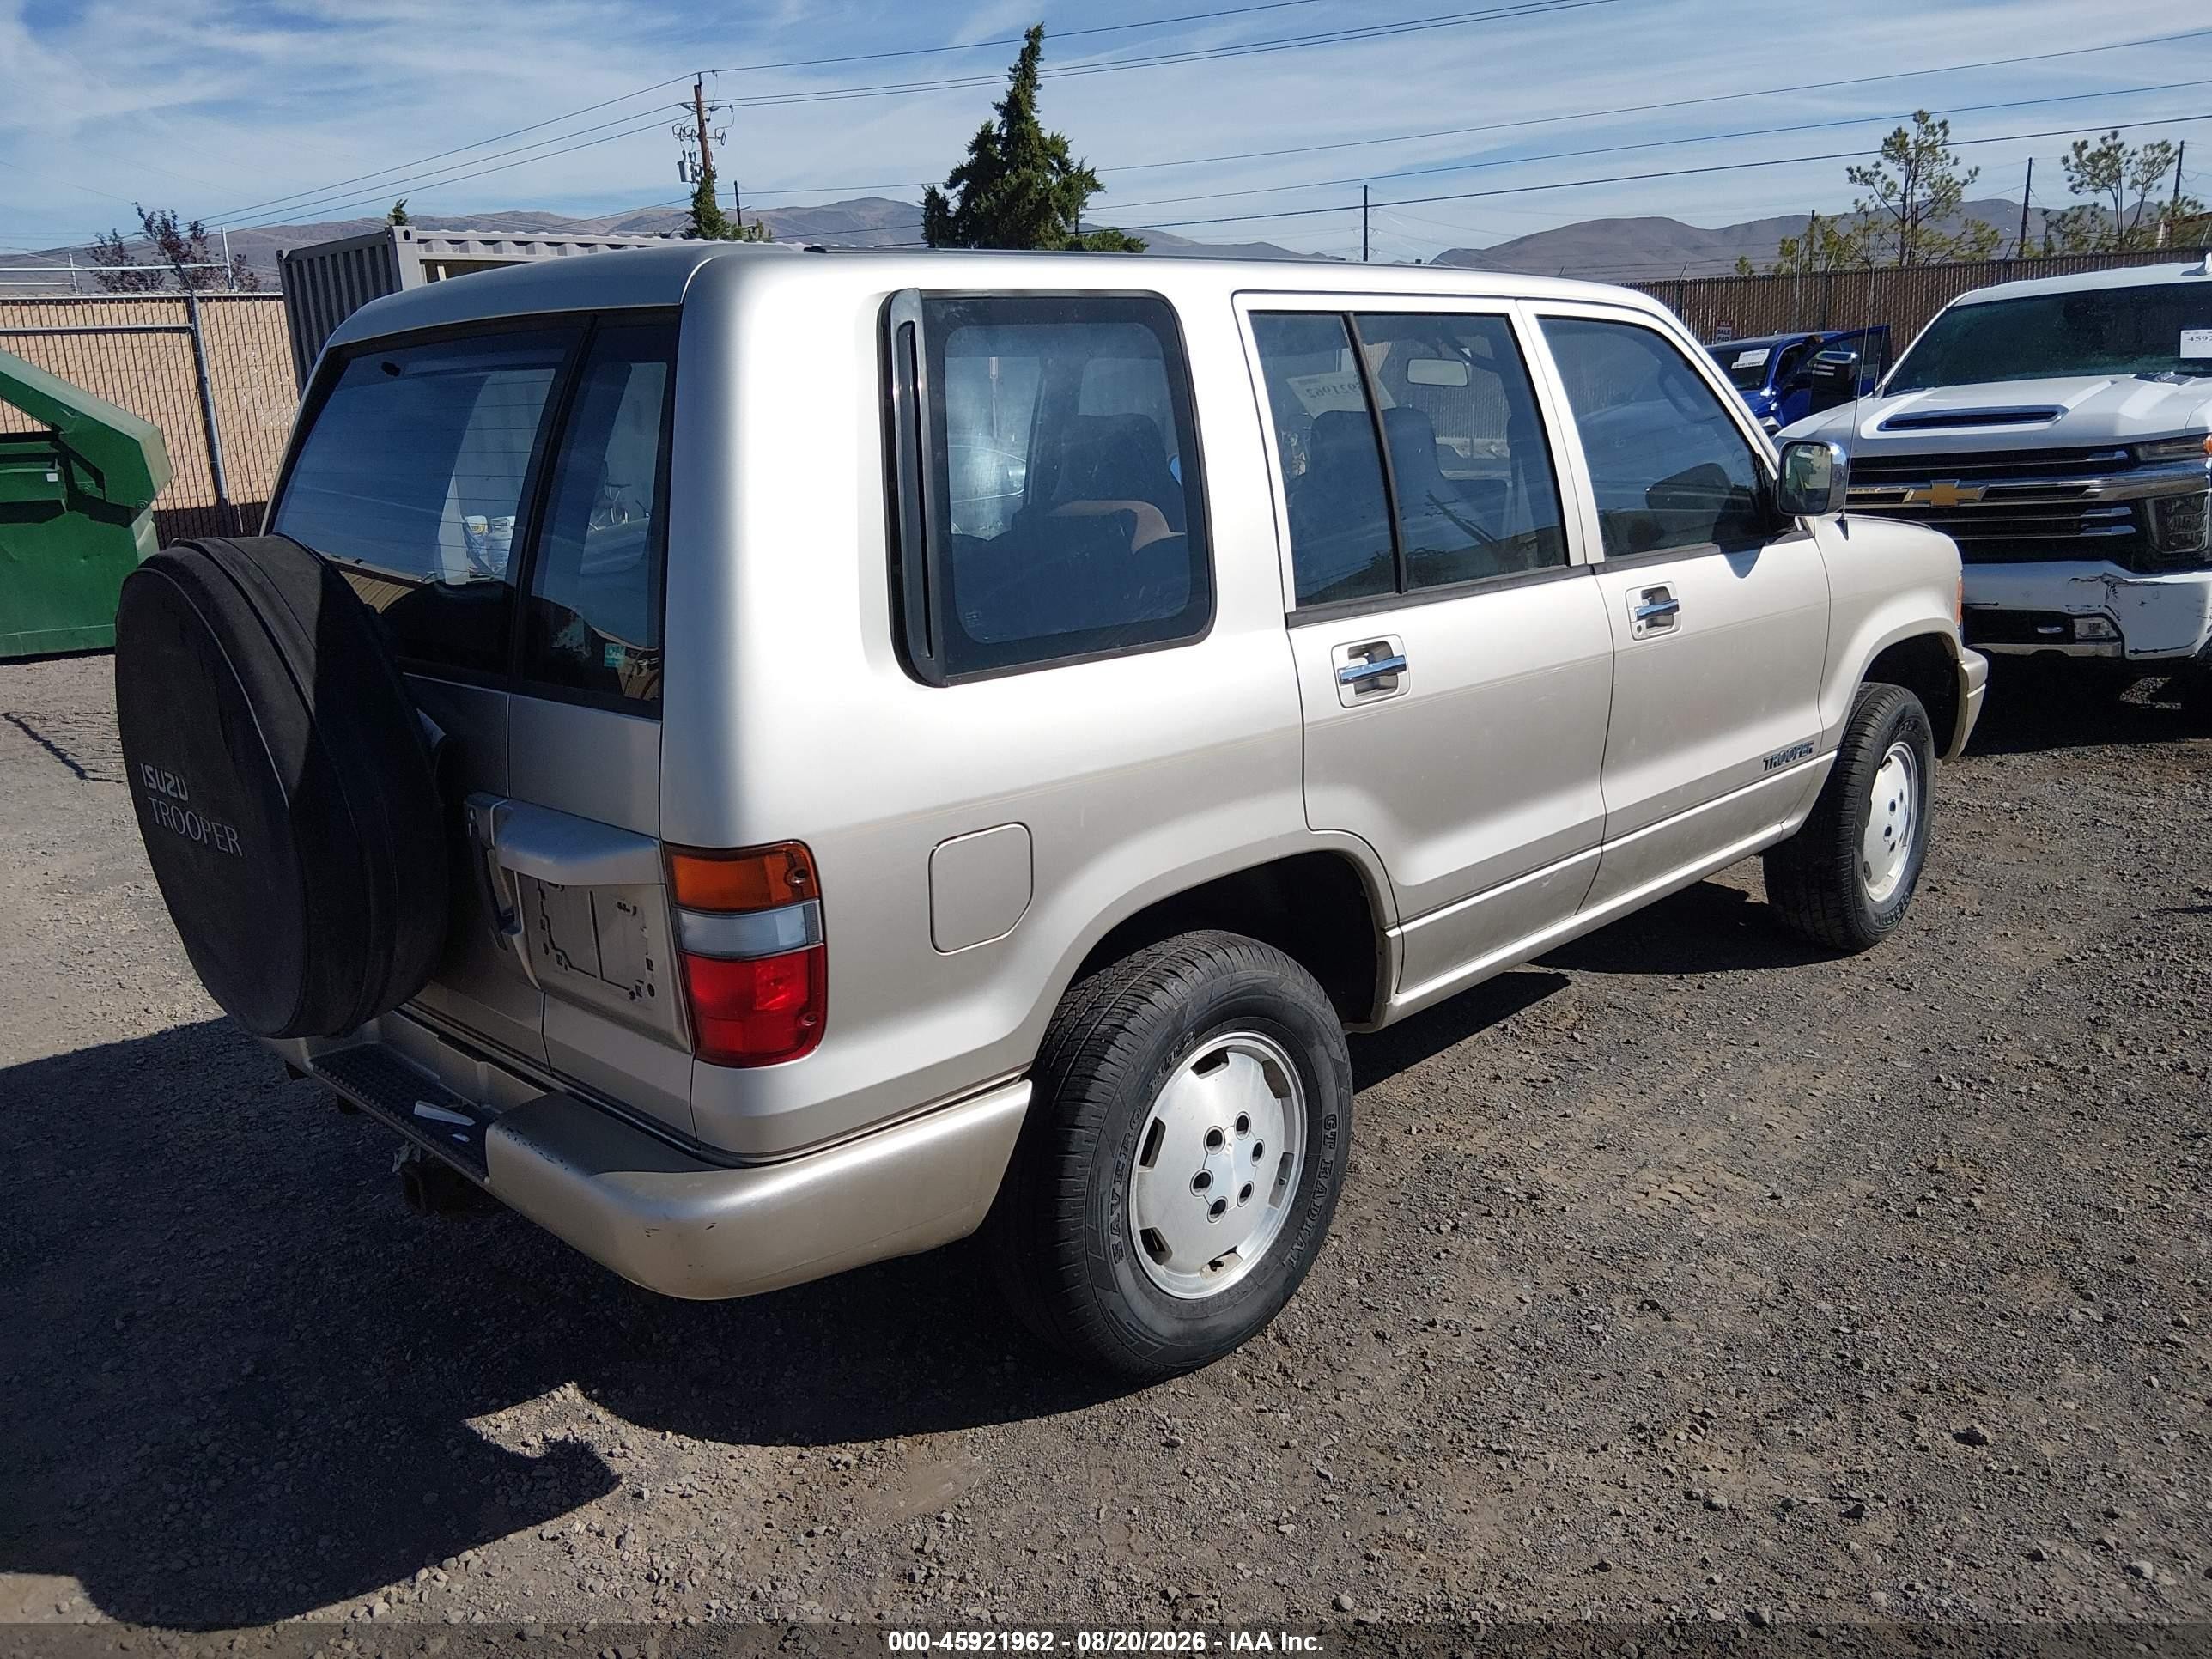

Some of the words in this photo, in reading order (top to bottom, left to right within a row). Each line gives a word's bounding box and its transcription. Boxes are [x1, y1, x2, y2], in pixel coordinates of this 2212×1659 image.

[1763, 740, 1814, 771] TROOPER
[140, 763, 189, 801] ISUZU
[147, 796, 243, 857] TROOPER
[1323, 1113, 1338, 1150] GT
[1110, 1104, 1143, 1265] SAVERO
[1282, 1159, 1334, 1271] RADIAL
